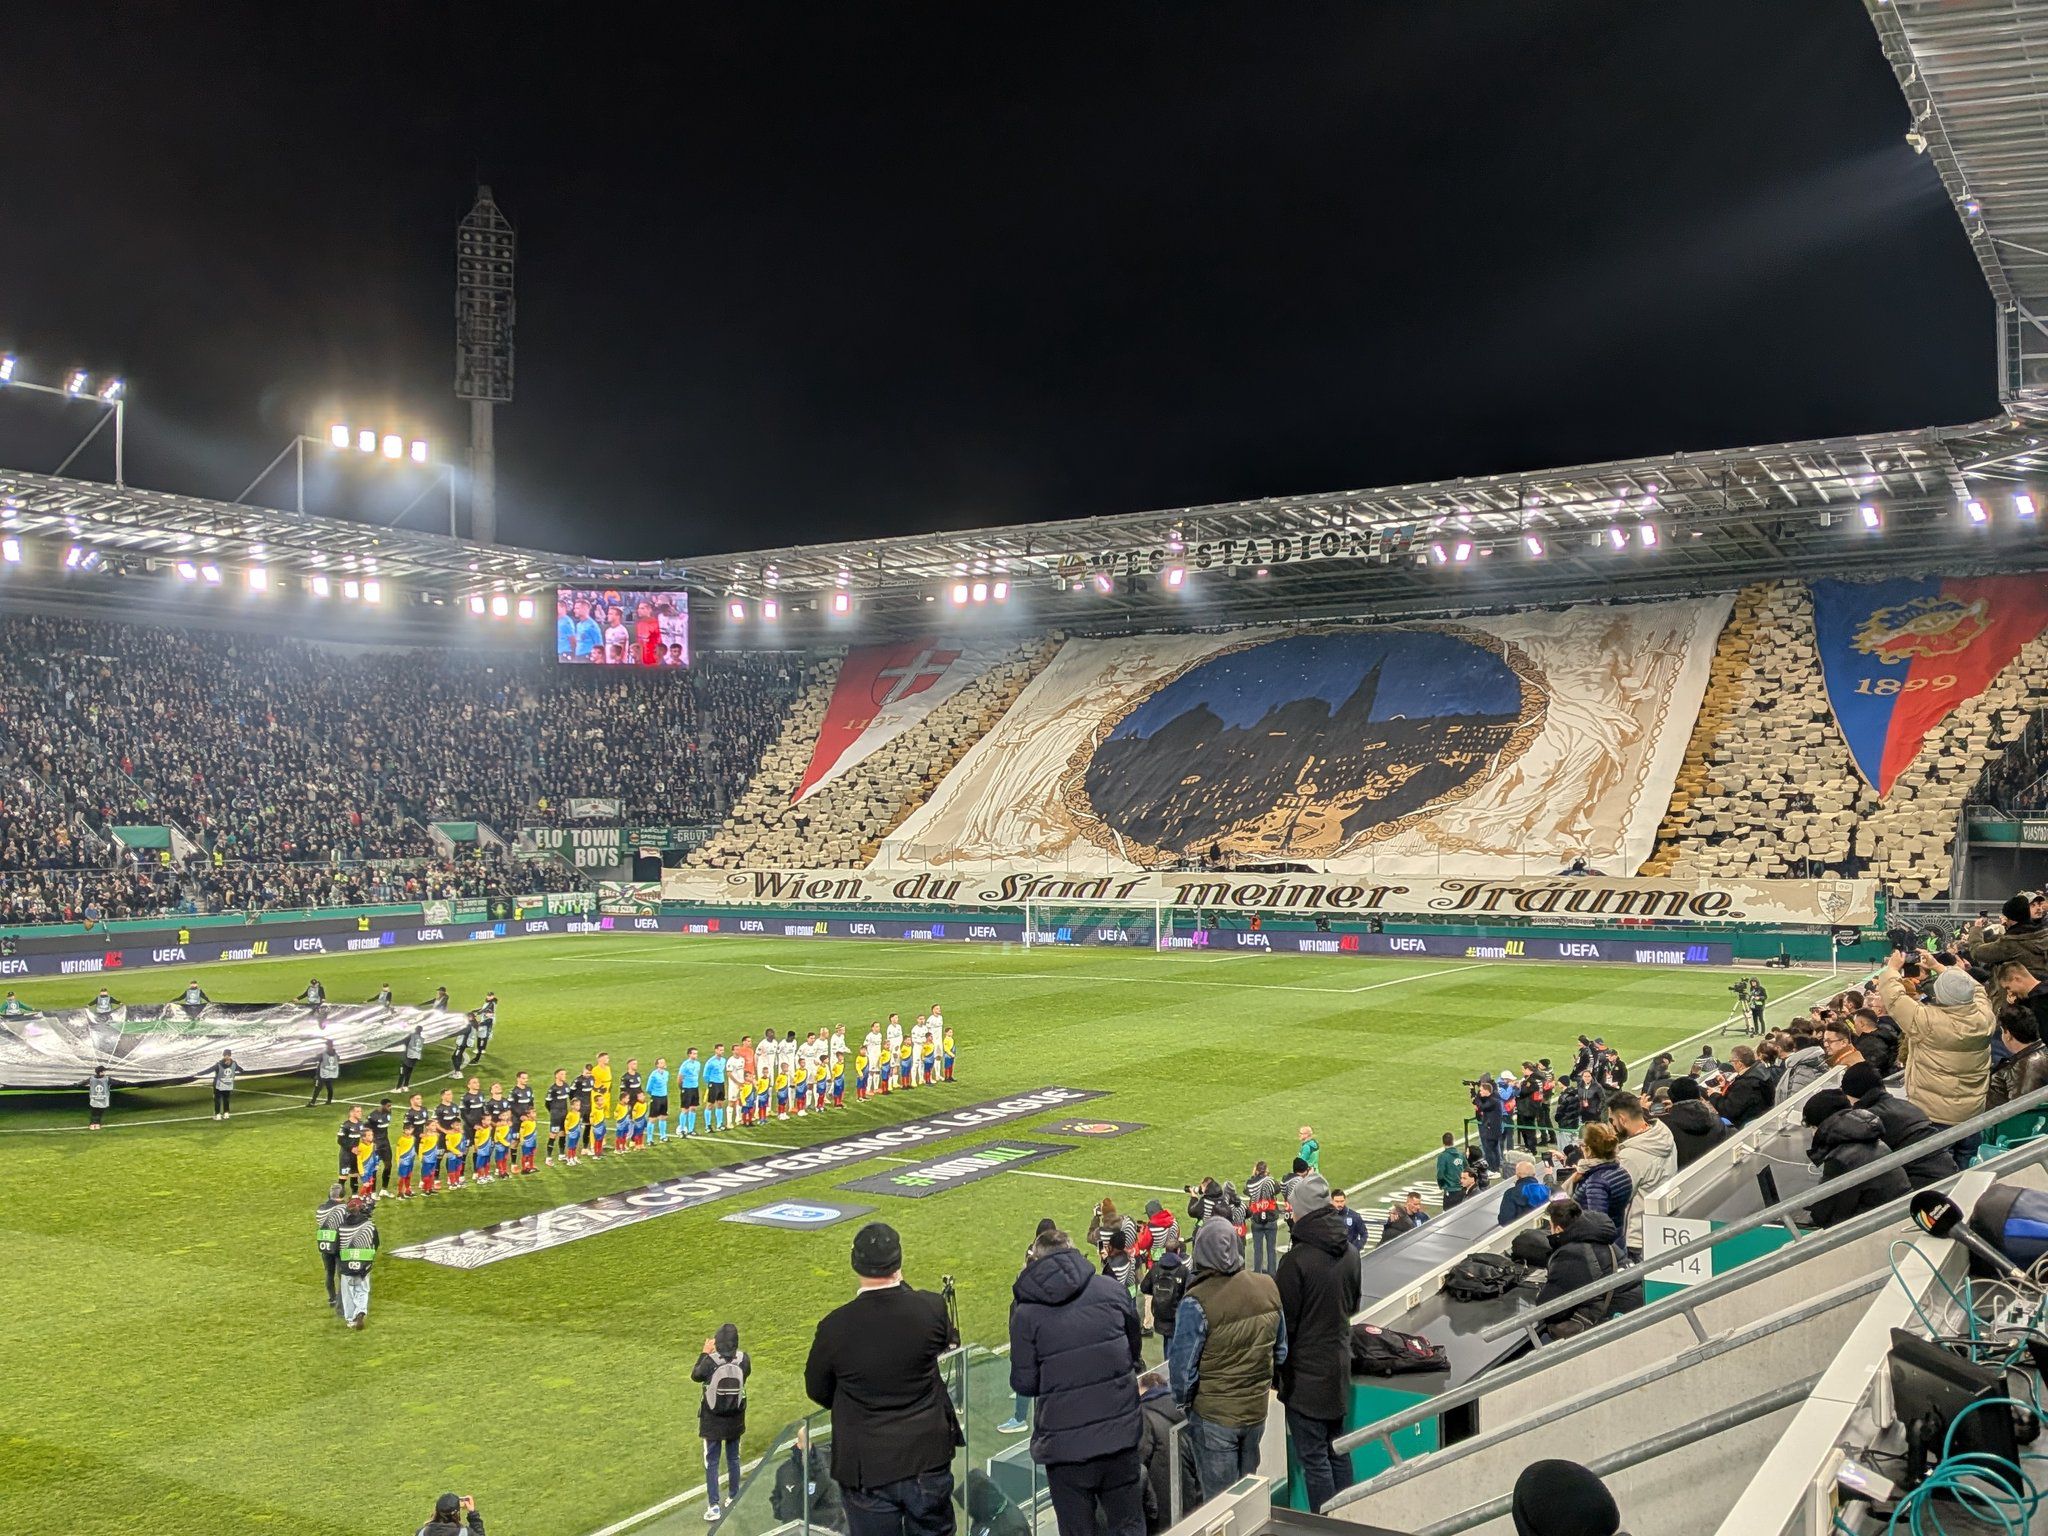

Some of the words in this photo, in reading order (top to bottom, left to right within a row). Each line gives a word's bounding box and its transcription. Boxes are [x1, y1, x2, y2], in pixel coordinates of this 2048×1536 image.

[1854, 674, 1958, 696] 1899
[571, 829, 620, 847] TOWN
[575, 847, 619, 868] BOYS
[727, 872, 872, 901] Wien,
[893, 872, 966, 901] du
[979, 873, 1149, 901] Stadt
[1175, 877, 1409, 908] meiner
[1428, 879, 1746, 918] Träume.
[526, 919, 549, 931] UEFA
[634, 918, 659, 929] UEFA
[740, 920, 764, 931] UEFA
[850, 923, 876, 935] UEFA
[418, 929, 443, 941] UEFA
[969, 926, 997, 937] UEFA
[1098, 929, 1128, 941] UEFA
[294, 938, 323, 950] UEFA
[1237, 933, 1269, 946] UEFA
[1390, 938, 1426, 951] UEFA
[153, 948, 186, 962] UEFA
[1559, 943, 1599, 957] UEFA
[626, 1124, 950, 1207] CONFERENCE
[929, 1087, 1085, 1128] LEAGUE
[1663, 1227, 1690, 1246] R6
